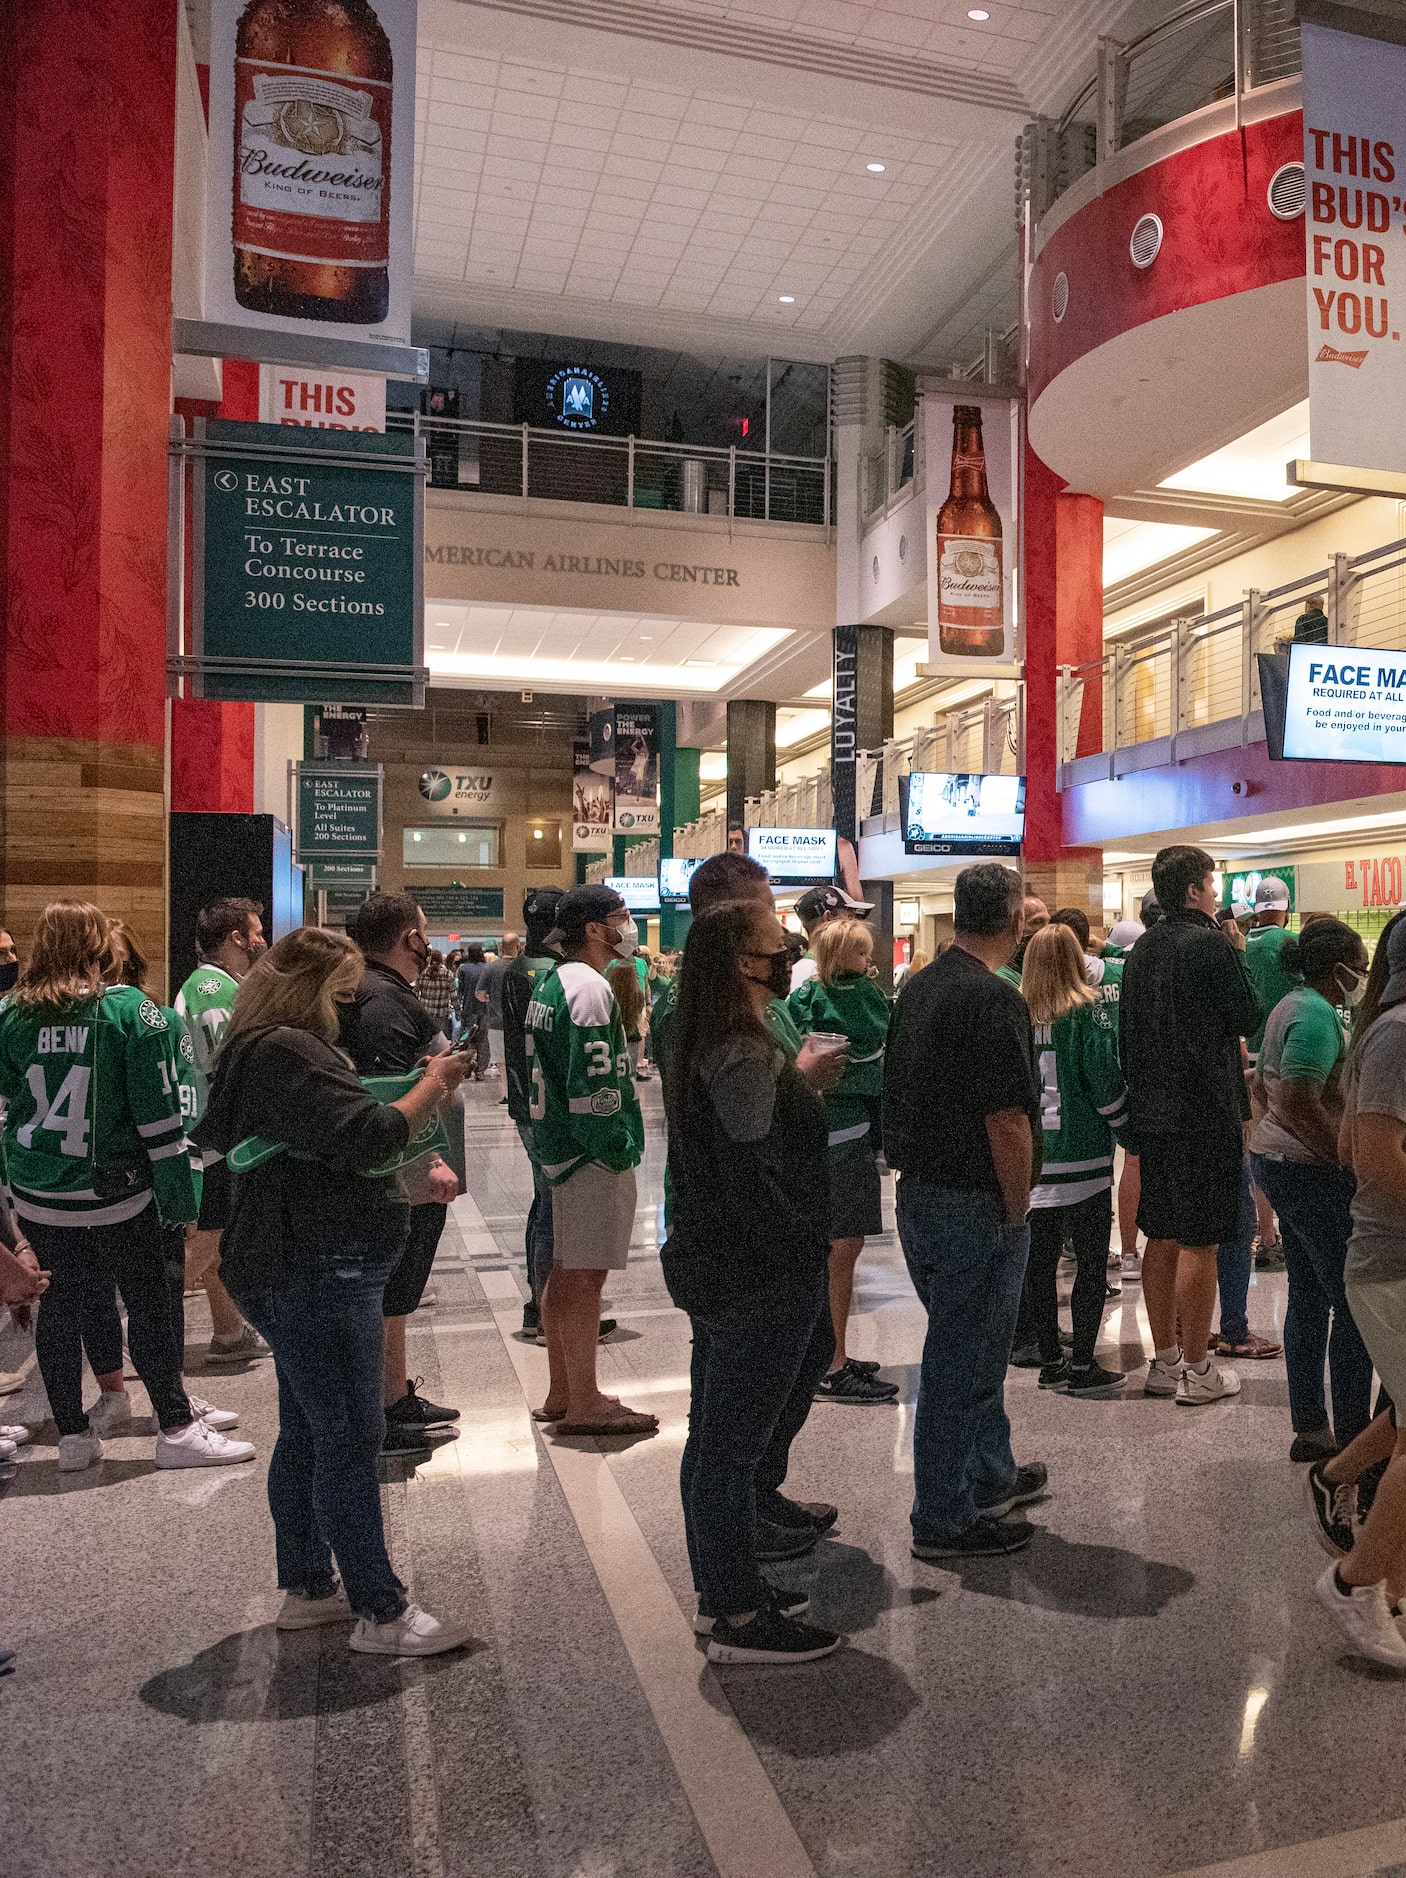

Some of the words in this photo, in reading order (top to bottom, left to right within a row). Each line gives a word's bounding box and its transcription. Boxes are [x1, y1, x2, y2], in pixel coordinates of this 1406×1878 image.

[1308, 127, 1396, 184] THIS
[239, 145, 385, 190] Budweiser
[264, 180, 292, 193] KING
[297, 187, 314, 196] OF
[1313, 234, 1386, 287] FOR
[1312, 287, 1401, 342] YOU.
[279, 379, 357, 417] THIS
[244, 473, 311, 497] EAST
[244, 497, 397, 527] ESCALATOR
[244, 534, 273, 555] To
[280, 537, 364, 560] Terrace
[244, 558, 366, 584] Concourse
[424, 545, 534, 569] MERICAN
[544, 554, 646, 578] AIRLINES
[653, 563, 741, 588] CENTER
[243, 590, 286, 610] 300
[292, 592, 386, 617] Sections
[1308, 662, 1371, 687] FACE
[1313, 687, 1367, 701] REQUIRED
[1369, 691, 1383, 701] AT
[1385, 692, 1404, 703] ALL
[835, 650, 856, 763] LOYALTY
[1306, 707, 1332, 718] Food
[322, 711, 364, 721] ENERGY
[616, 713, 651, 722] POWER
[616, 727, 655, 736] ENERGY
[1315, 719, 1328, 730] be
[1330, 721, 1370, 733] enjoyed
[1372, 723, 1382, 732] in
[1384, 724, 1406, 734] your
[314, 780, 340, 789] EAST
[454, 775, 493, 791] TXU
[314, 788, 372, 798] ESCALATOR
[454, 790, 491, 802] energy
[314, 803, 326, 811] To
[327, 803, 367, 813] Platinum
[314, 811, 337, 820] Level
[636, 814, 655, 823] TXU
[314, 824, 328, 832] All
[328, 824, 356, 832] Suites
[590, 827, 607, 835] TXU
[314, 832, 327, 841] 200
[327, 833, 367, 842] Sections
[759, 835, 790, 845] FACE
[792, 836, 827, 845] MASK
[913, 844, 952, 853] GEICO
[1345, 860, 1358, 890] EL
[1359, 857, 1402, 907] TACO
[584, 1040, 612, 1078] 3
[178, 1084, 198, 1119] 91
[17, 1062, 92, 1158] 14
